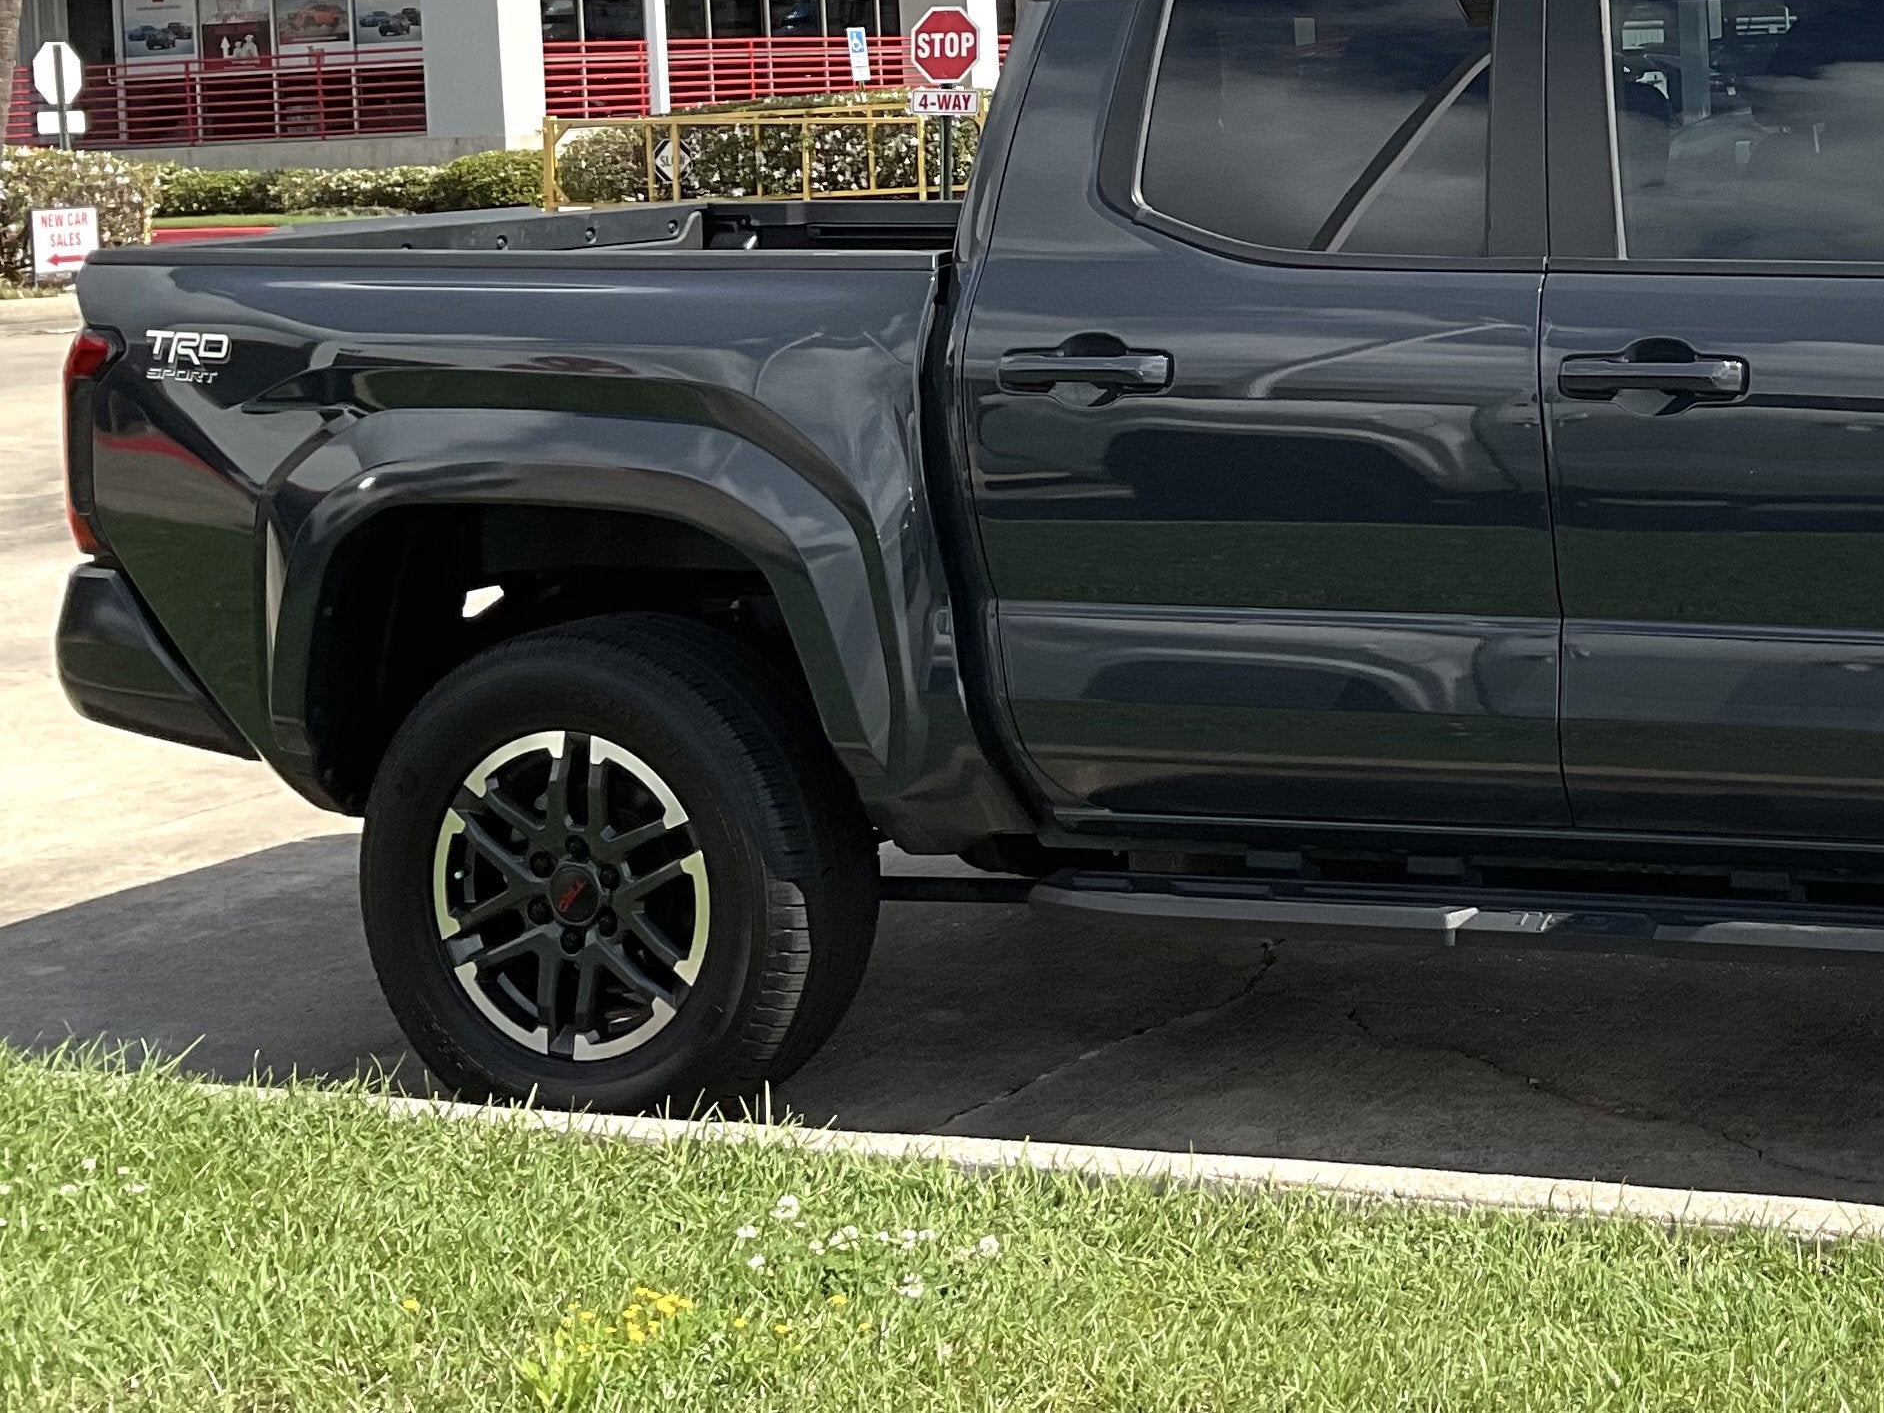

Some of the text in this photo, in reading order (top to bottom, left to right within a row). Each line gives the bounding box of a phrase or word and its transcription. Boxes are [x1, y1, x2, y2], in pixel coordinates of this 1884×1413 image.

[916, 31, 975, 59] STOP
[918, 94, 972, 111] 4-WAY
[660, 154, 686, 168] SL
[41, 211, 89, 228] NEW CAR
[50, 231, 82, 248] SALES
[145, 329, 230, 366] TRD
[145, 368, 219, 384] SPORT
